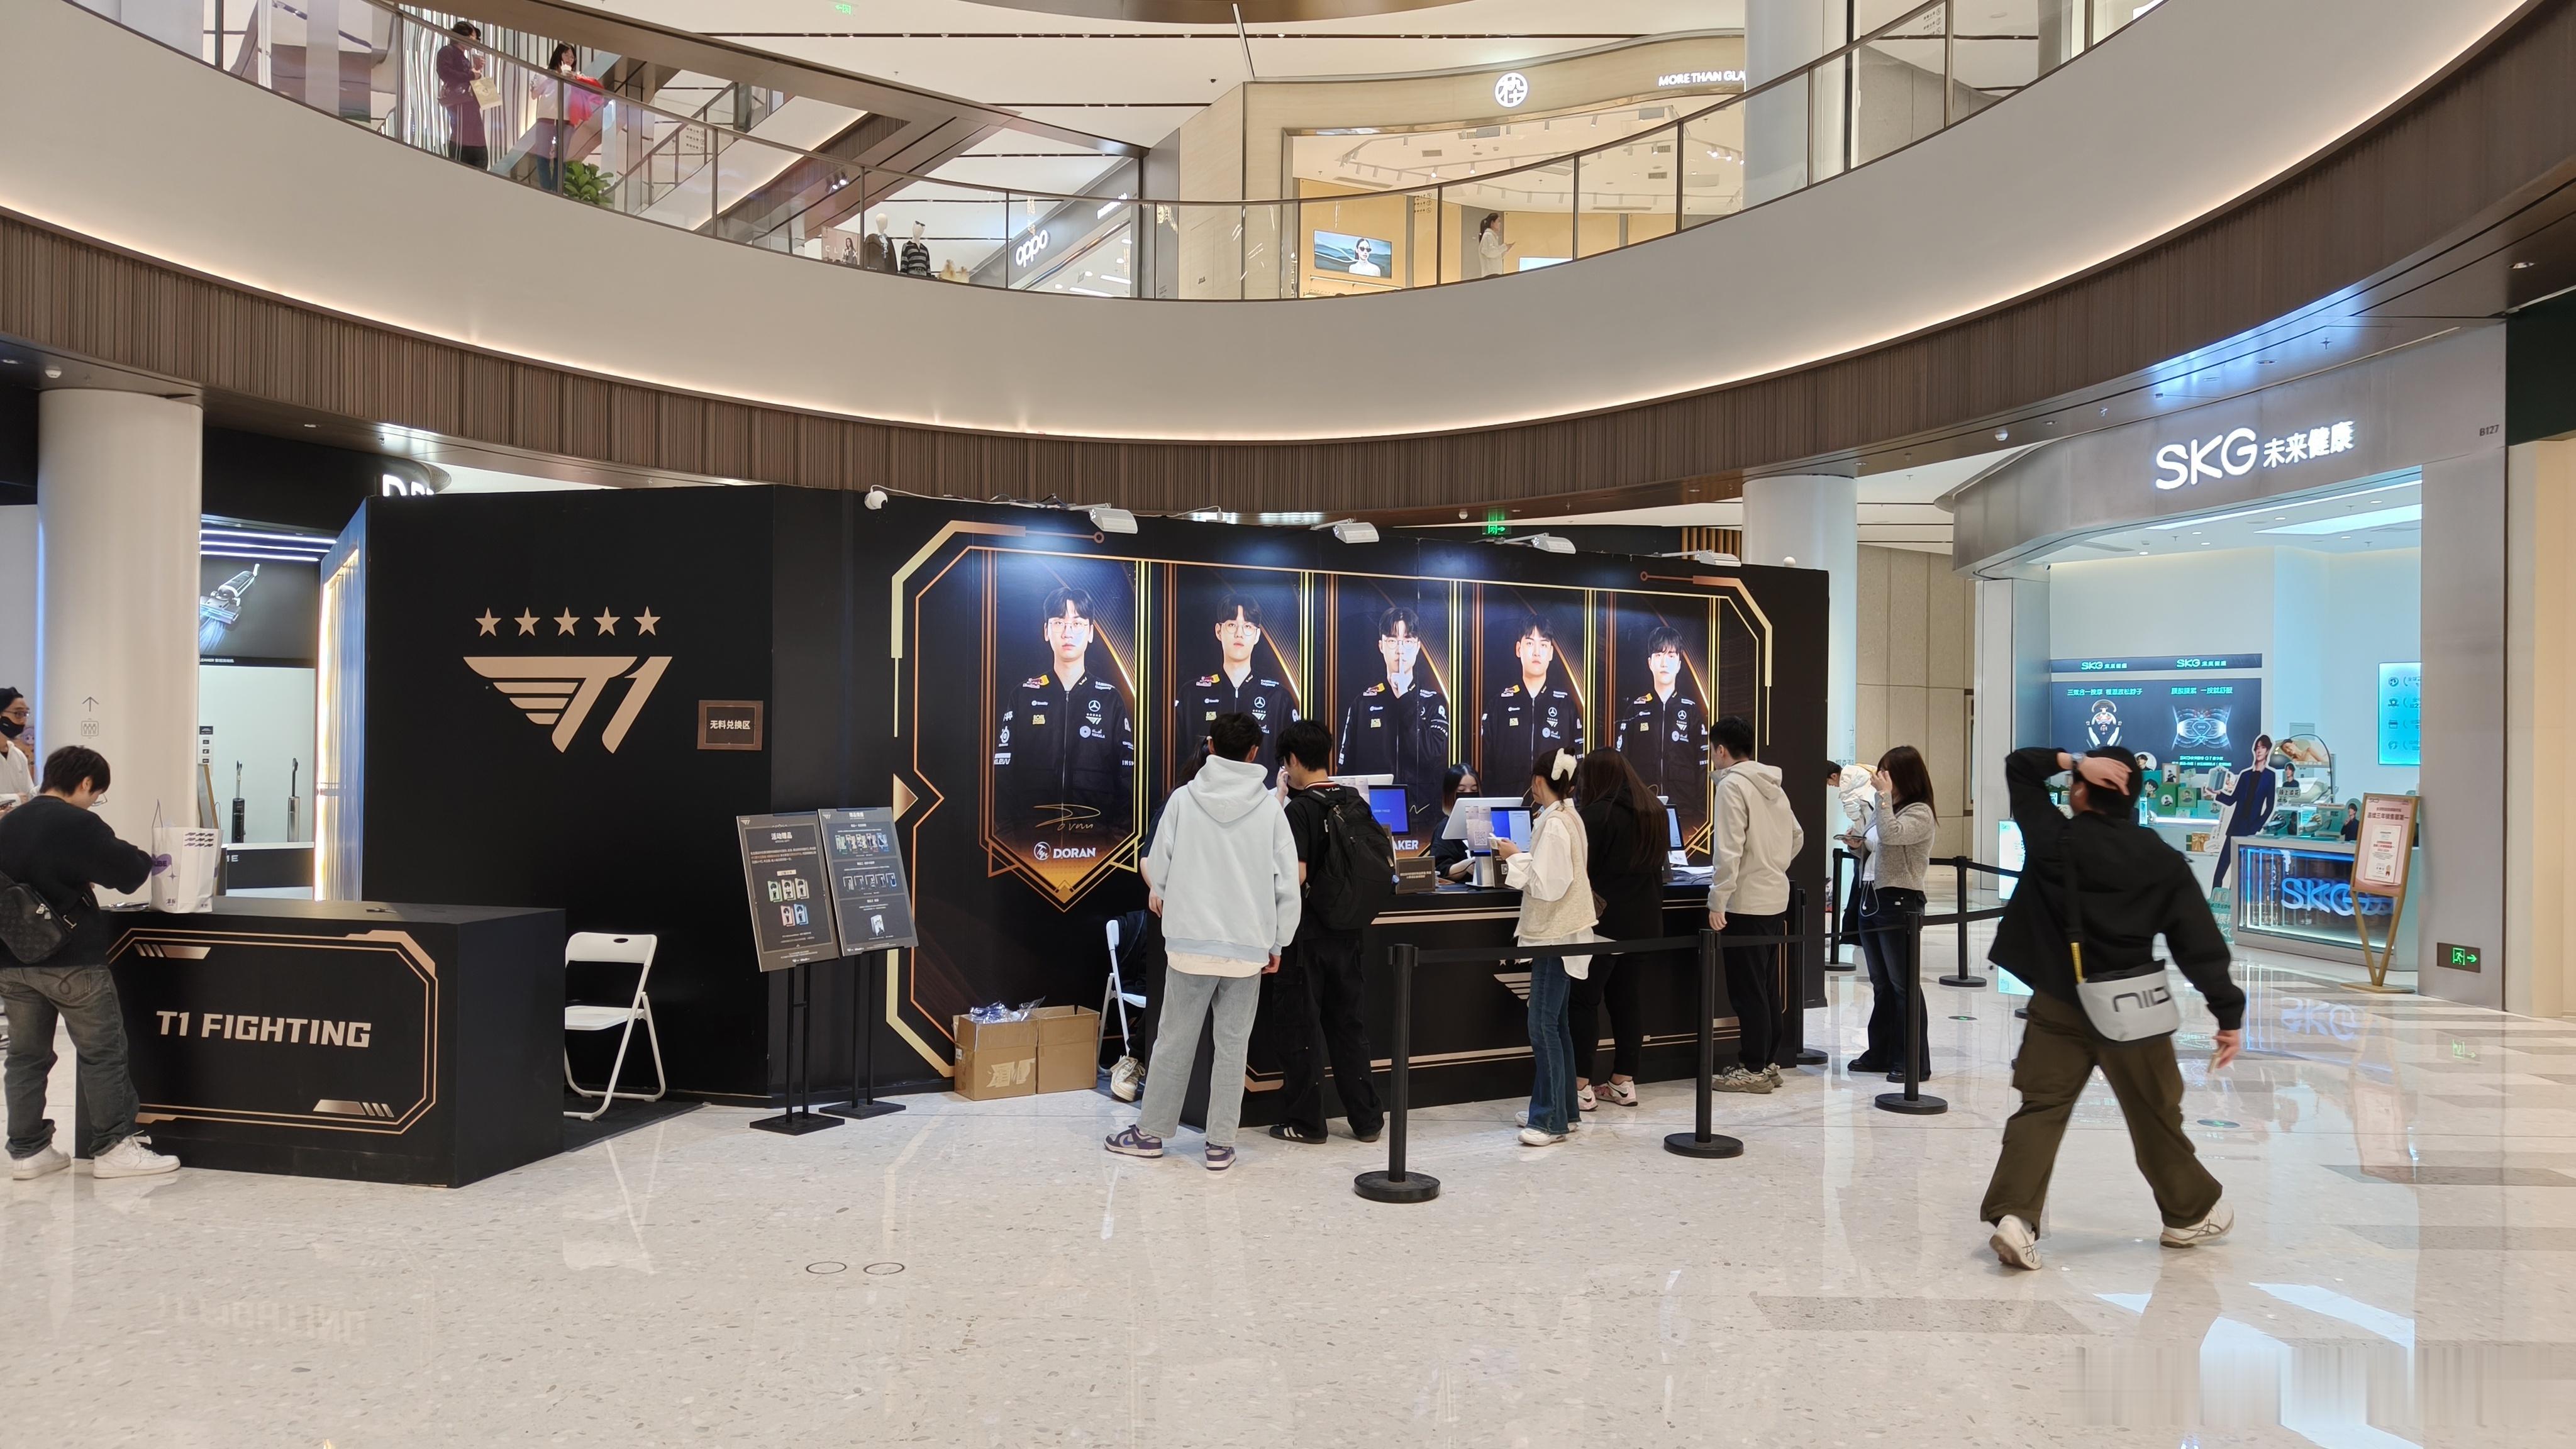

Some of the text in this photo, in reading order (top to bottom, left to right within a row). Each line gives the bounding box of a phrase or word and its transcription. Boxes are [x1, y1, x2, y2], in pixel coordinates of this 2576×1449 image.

[1658, 74, 1690, 86] MORE
[1691, 71, 1722, 82] THAN
[2480, 425, 2499, 436] B127
[2156, 421, 2355, 489] SKG 未来健康
[2082, 661, 2103, 670] SKG
[2177, 658, 2201, 667] SKG
[463, 656, 673, 753] T1
[709, 719, 751, 730] 无料兑换区
[1053, 847, 1096, 859] DORAN
[157, 1010, 371, 1048] T1 FIGHTING
